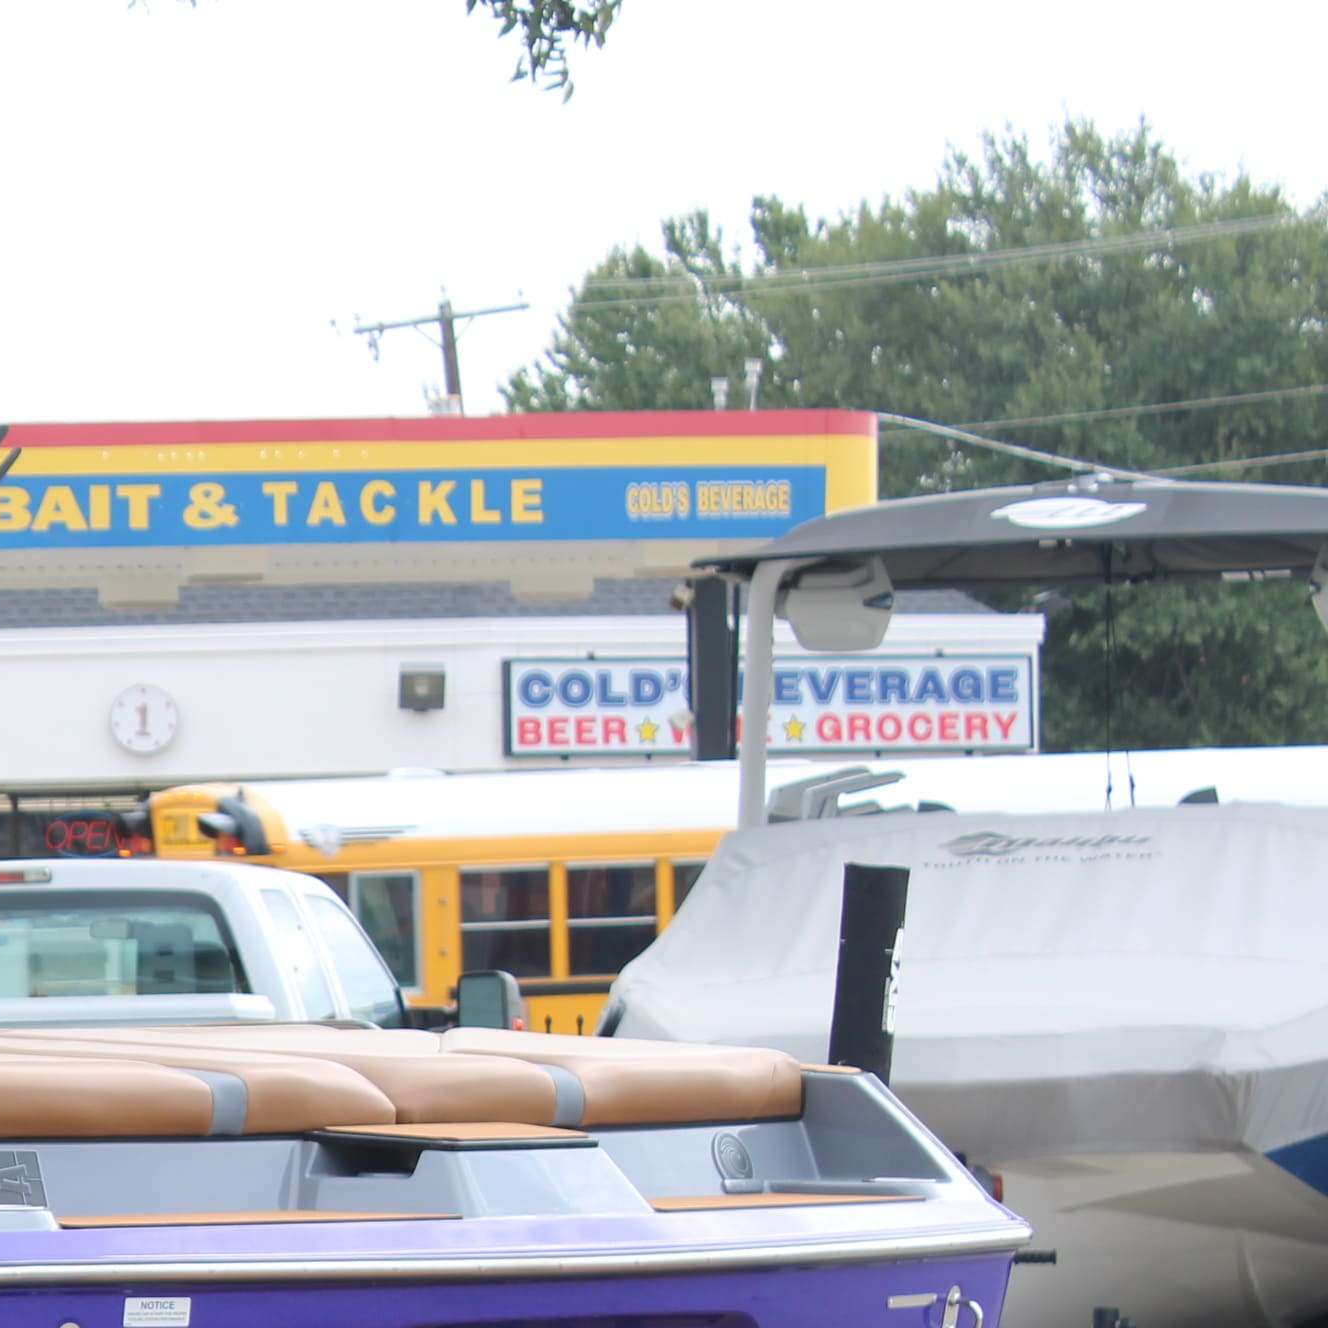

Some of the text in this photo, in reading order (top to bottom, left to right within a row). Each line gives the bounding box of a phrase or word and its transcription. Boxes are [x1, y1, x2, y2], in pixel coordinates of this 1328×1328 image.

[182, 481, 239, 530] &
[626, 480, 792, 518] COLD'S BEVERAGE
[518, 668, 1020, 707] COLD' EVERAGE
[517, 711, 1019, 745] BEER GROCERY
[141, 1301, 176, 1310] NOTICE
